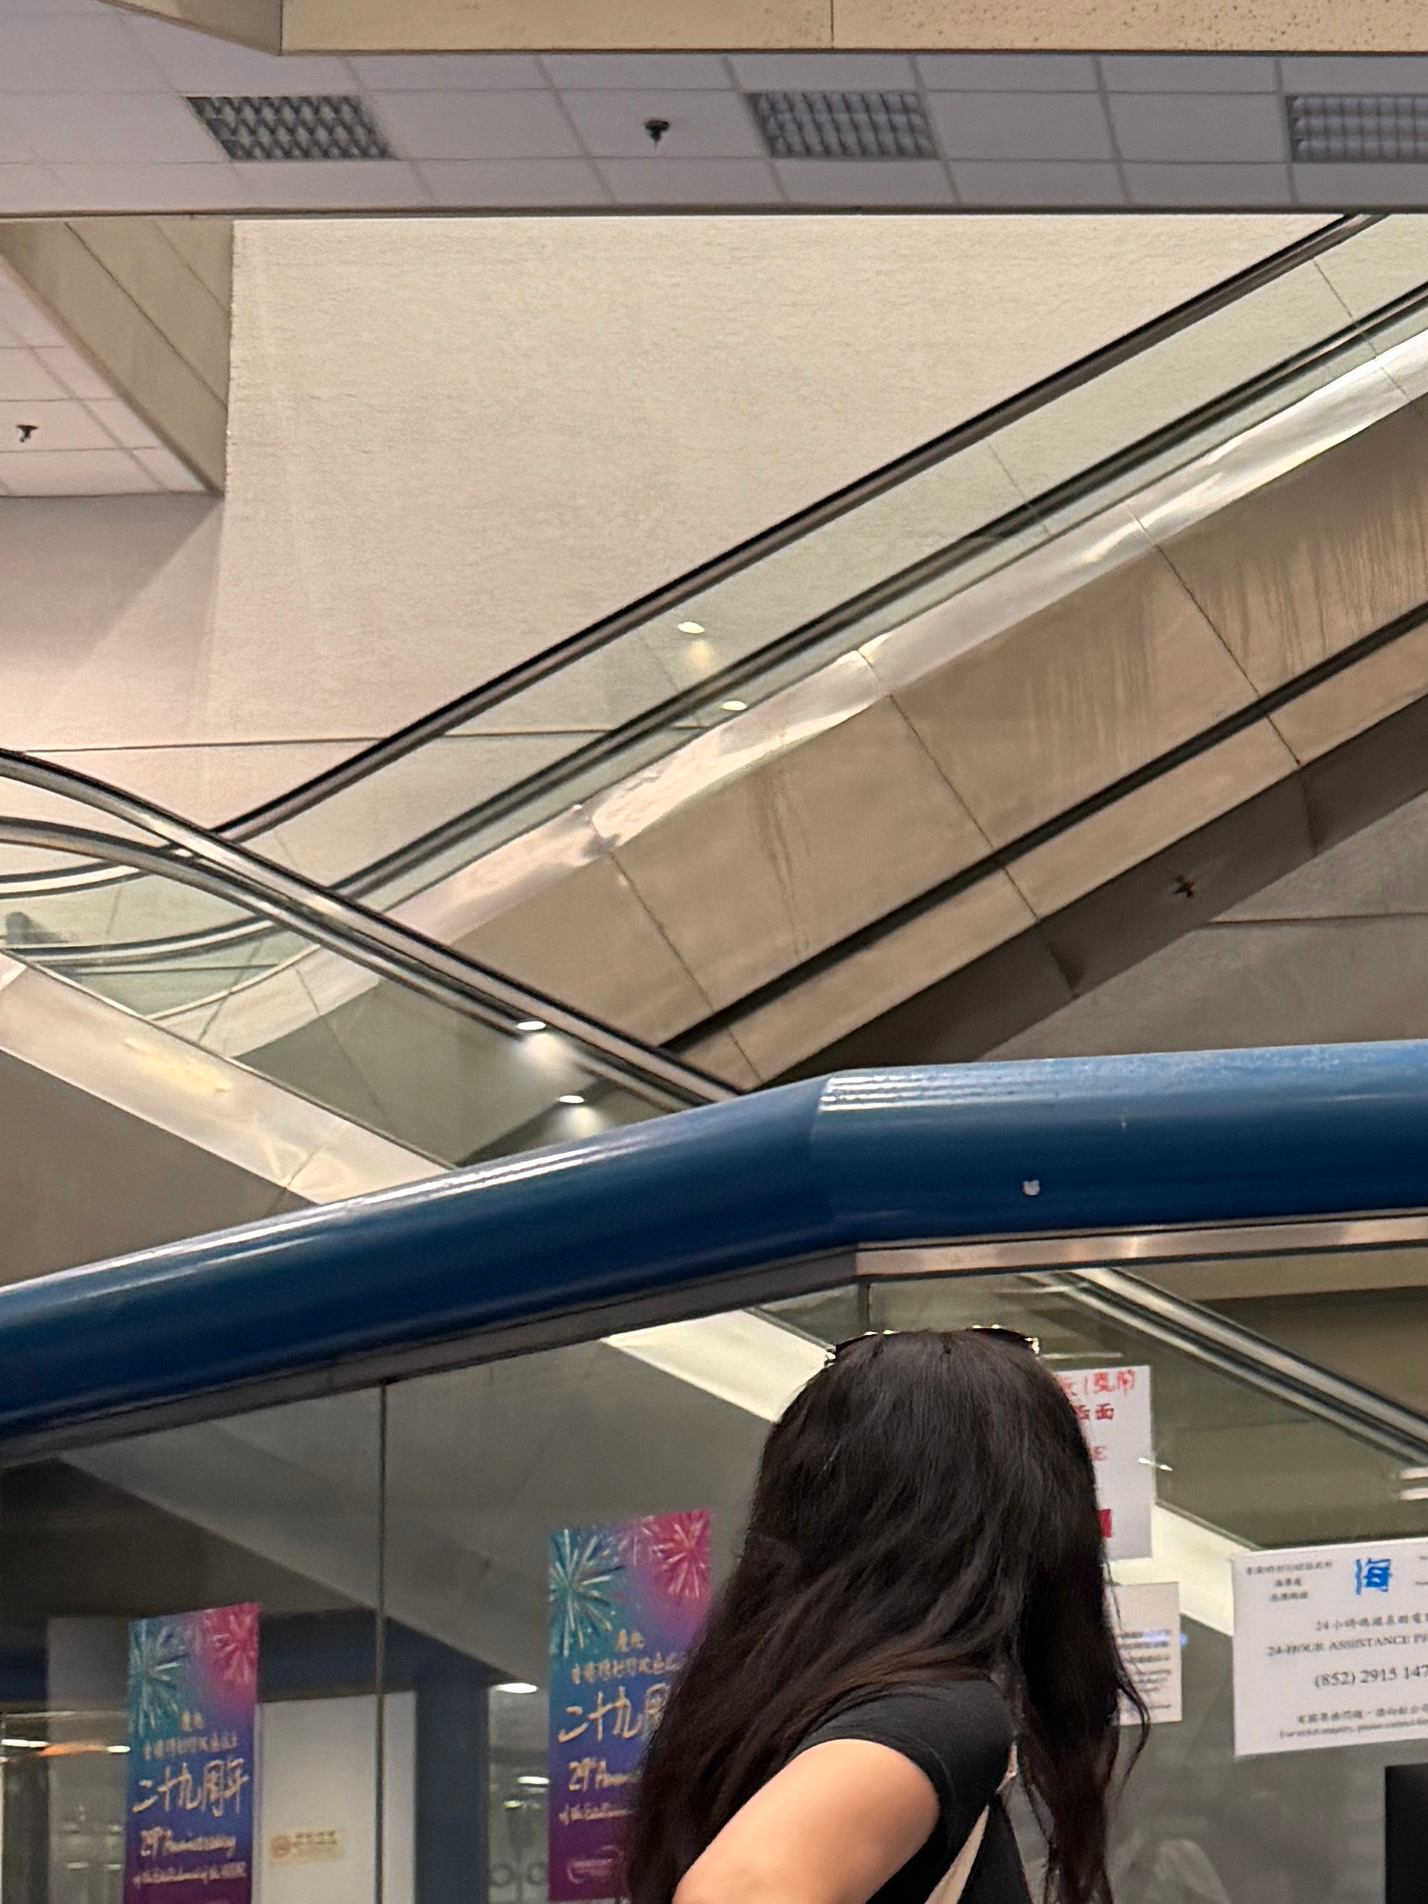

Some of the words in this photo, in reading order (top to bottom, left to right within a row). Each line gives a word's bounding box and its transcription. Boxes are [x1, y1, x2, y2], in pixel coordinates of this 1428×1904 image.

[1329, 1634, 1410, 1652] ASSISTANCE
[1314, 1671, 1356, 1689] (852)
[1360, 1667, 1398, 1684] 2915
[558, 1682, 673, 1744] 二十九周
